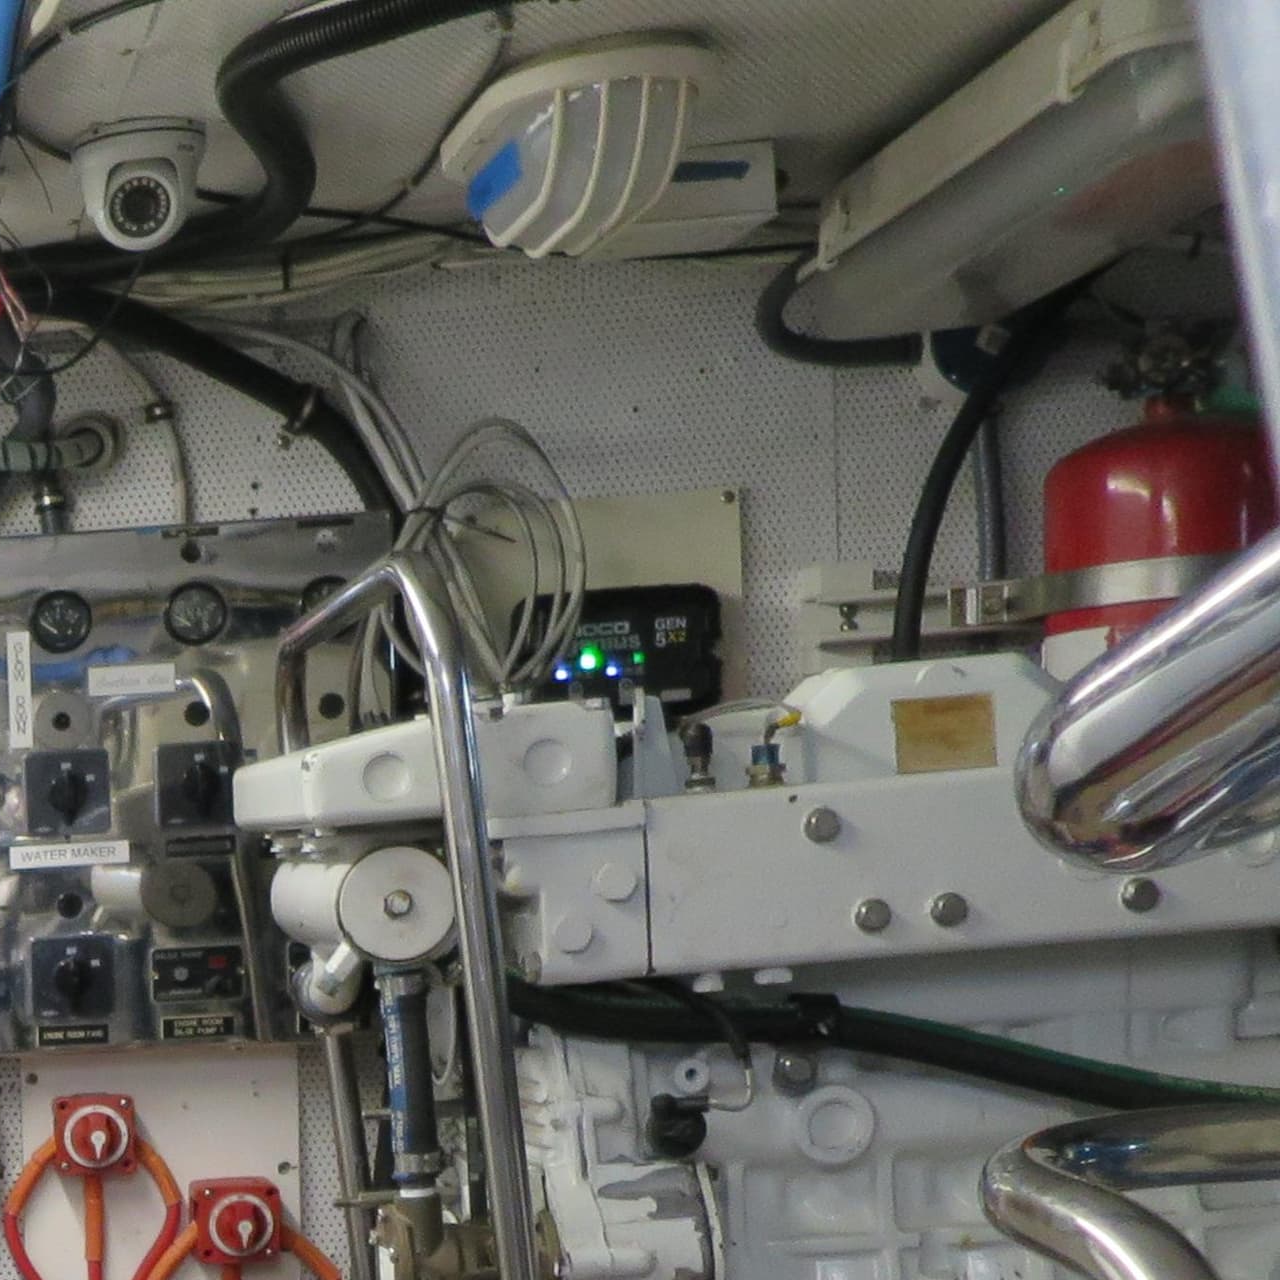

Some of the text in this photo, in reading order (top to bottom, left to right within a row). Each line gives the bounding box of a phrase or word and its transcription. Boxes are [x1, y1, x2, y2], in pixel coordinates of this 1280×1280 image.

[654, 616, 688, 630] GEN
[20, 845, 117, 863] WATER MAKER
